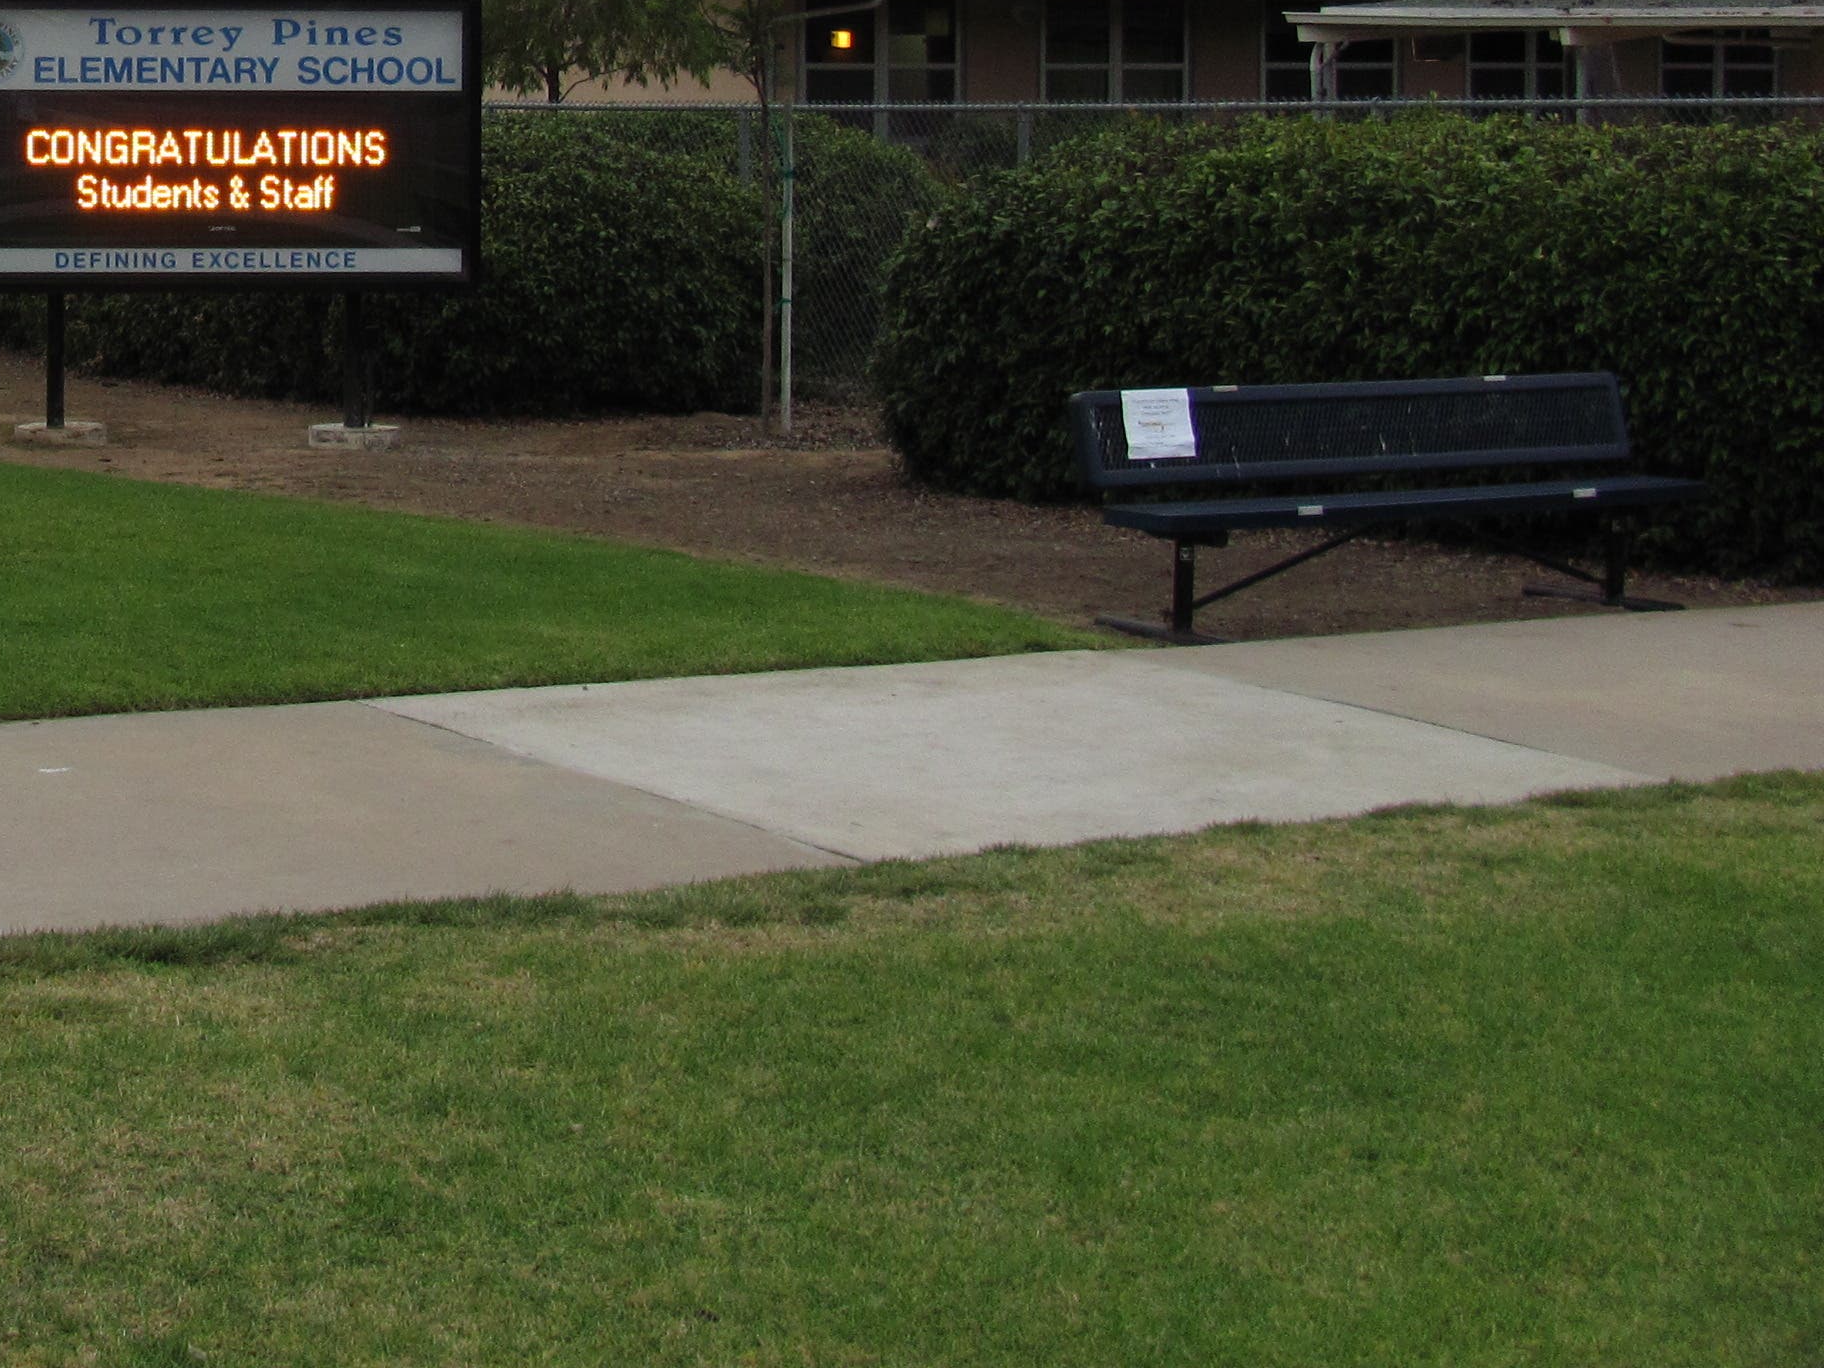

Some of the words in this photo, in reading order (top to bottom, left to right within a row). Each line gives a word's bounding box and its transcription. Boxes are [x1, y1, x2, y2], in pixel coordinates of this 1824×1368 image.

[88, 17, 244, 52] Torrey
[271, 18, 403, 46] Pines
[33, 56, 281, 84] ELEMENTARY
[296, 56, 456, 85] SCHOOL
[26, 131, 386, 165] CONGRATULATIONS
[77, 175, 220, 209] Students
[229, 175, 251, 209] &
[259, 175, 335, 209] Staff
[55, 252, 177, 269] DEFINING
[192, 252, 357, 269] EXCELLENCE
